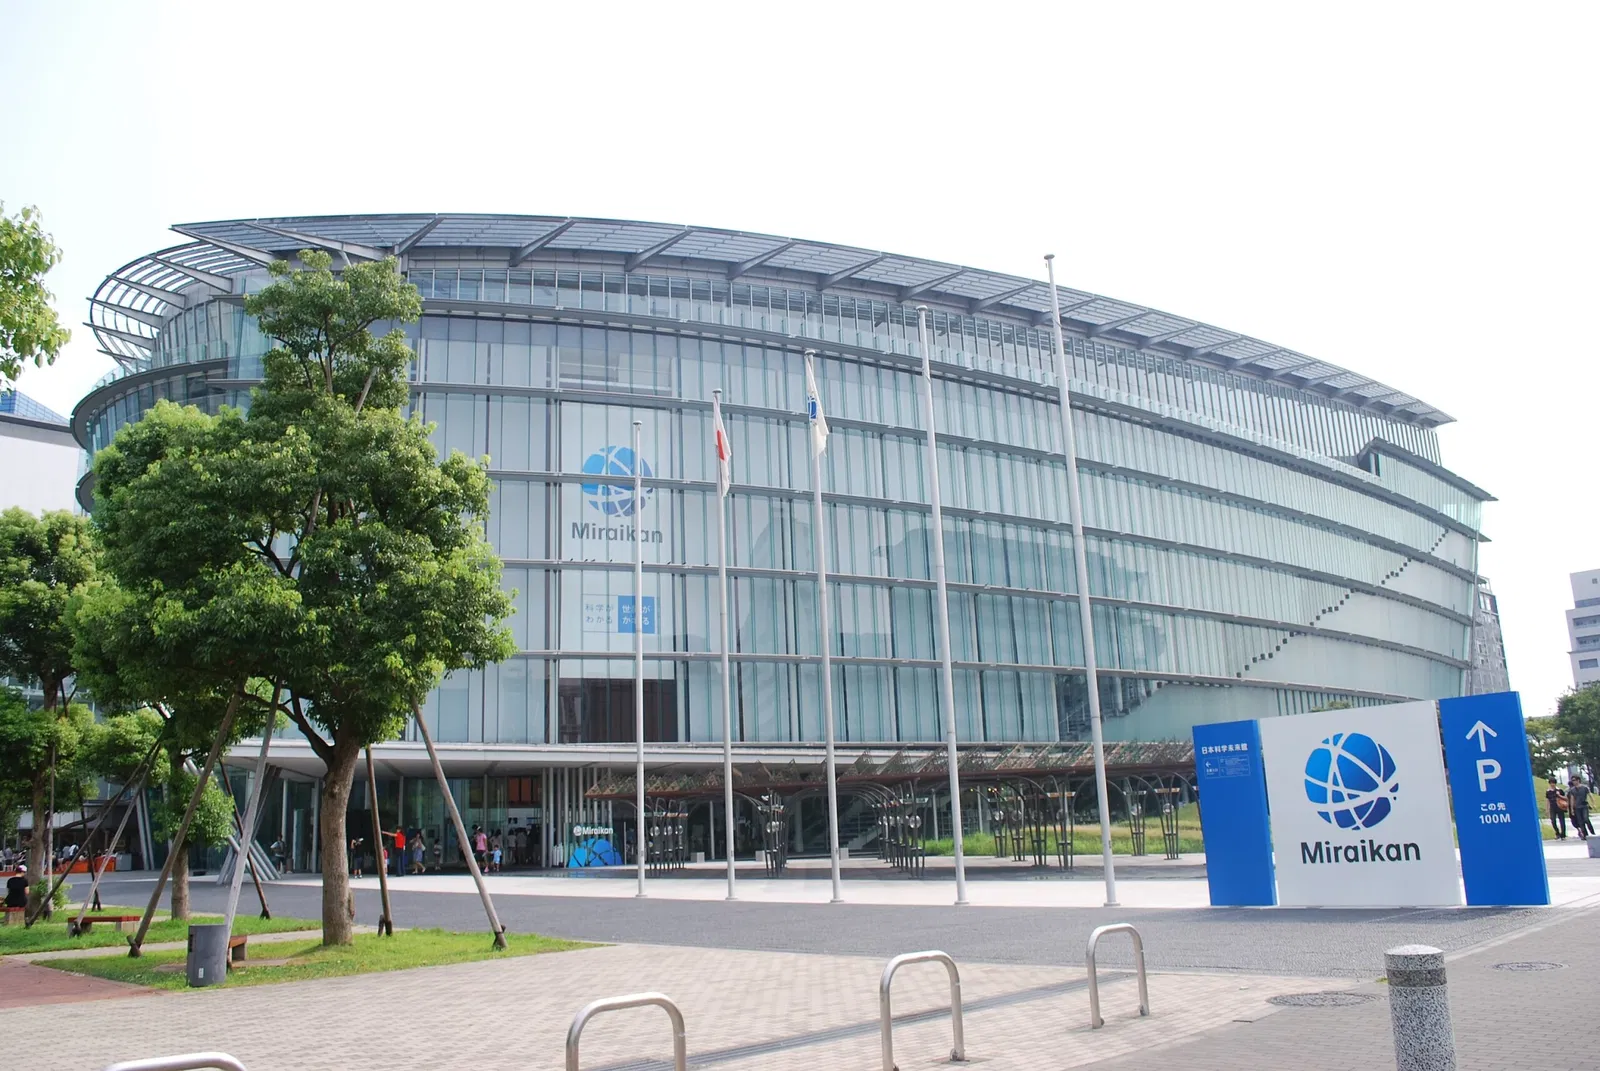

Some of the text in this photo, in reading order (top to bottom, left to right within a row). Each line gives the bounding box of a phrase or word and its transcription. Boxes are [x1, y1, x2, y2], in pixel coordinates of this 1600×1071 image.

[571, 522, 664, 543] Miraikan
[621, 604, 652, 614] 世が
[622, 616, 650, 625] かる
[1475, 758, 1502, 792] P
[1480, 802, 1506, 812] この先
[1479, 813, 1511, 824] 100M
[582, 826, 614, 835] Miraikan
[1300, 839, 1421, 864] Miraikan
